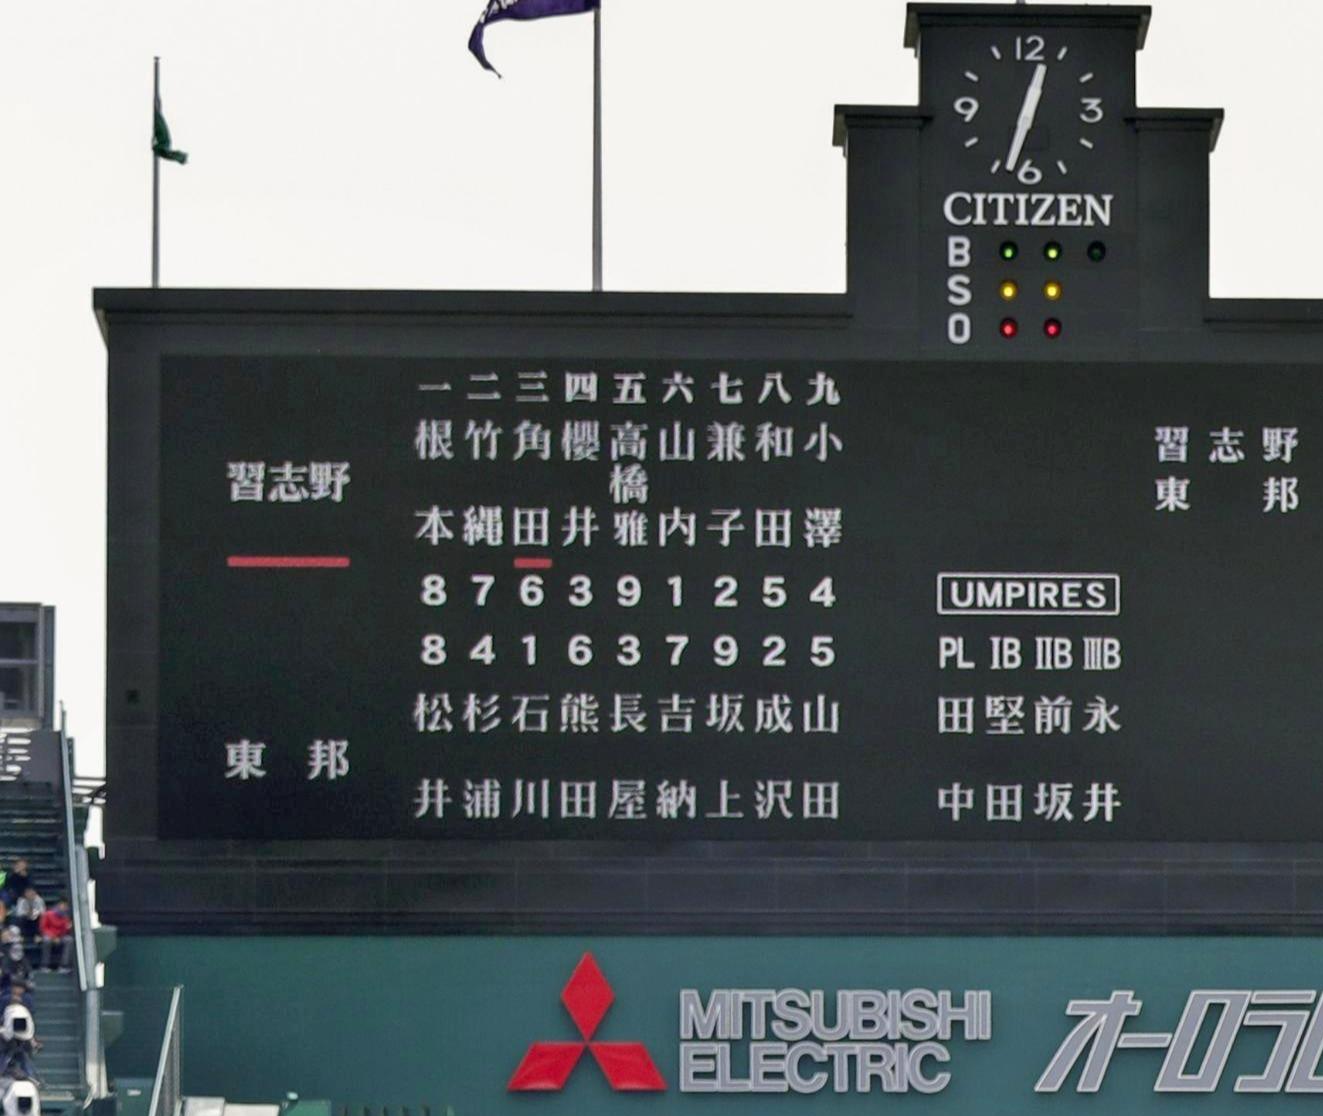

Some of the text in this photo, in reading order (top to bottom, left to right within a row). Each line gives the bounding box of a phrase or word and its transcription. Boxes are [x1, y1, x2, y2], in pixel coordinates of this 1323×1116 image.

[1015, 35, 1046, 62] 12
[953, 96, 980, 123] 9
[1079, 97, 1104, 124] 3
[1016, 158, 1043, 186] 6
[943, 191, 1114, 227] CITIZEN
[947, 235, 972, 268] B
[947, 273, 973, 306] S
[228, 461, 352, 503] 習志野
[950, 580, 1107, 609] UMPIRES
[939, 636, 976, 669] PL
[679, 987, 993, 1041] MITSUBISHI
[679, 1041, 952, 1095] ELECTRIC
